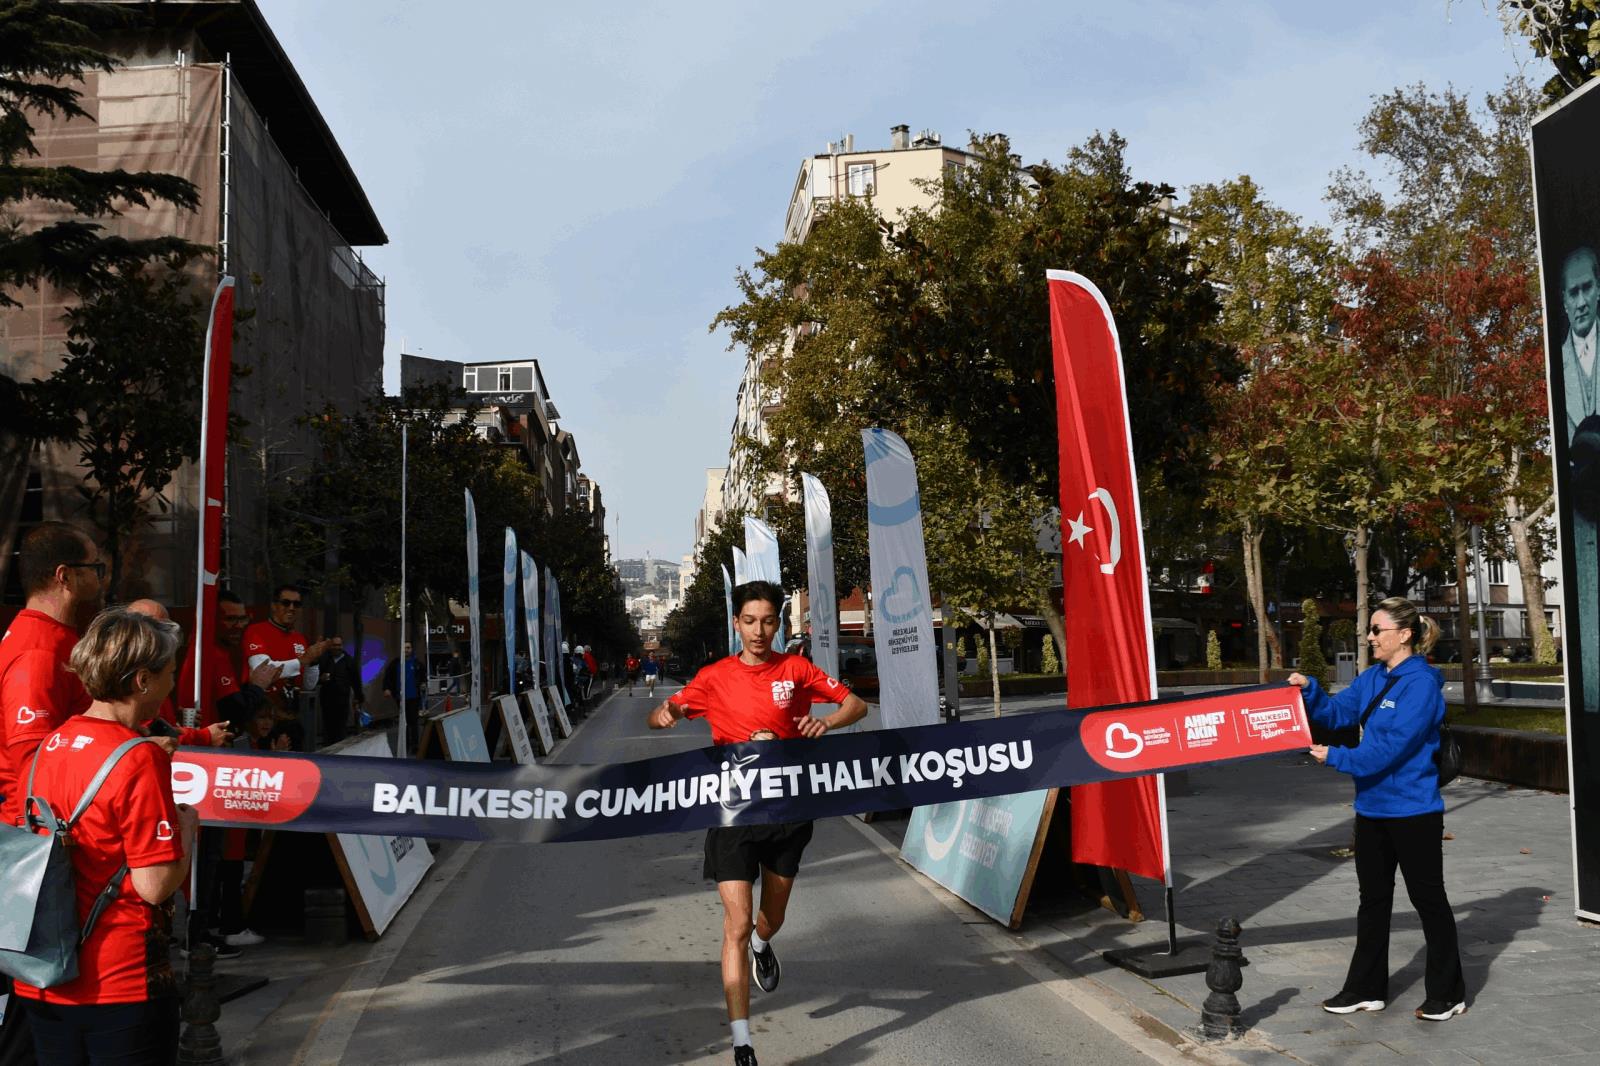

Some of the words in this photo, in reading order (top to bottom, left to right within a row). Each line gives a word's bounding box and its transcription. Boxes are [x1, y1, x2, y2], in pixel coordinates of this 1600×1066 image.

[771, 680, 795, 693] 29
[1184, 711, 1226, 729] AHMET
[1250, 711, 1290, 722] BALIKESİR
[1186, 725, 1218, 741] AKIN
[575, 760, 802, 819] CUMHURİYET
[809, 754, 895, 794] HALK
[900, 740, 1034, 788] KOŞUSU
[213, 788, 281, 802] CUMHURİYET
[224, 799, 270, 812] BAYRAMI
